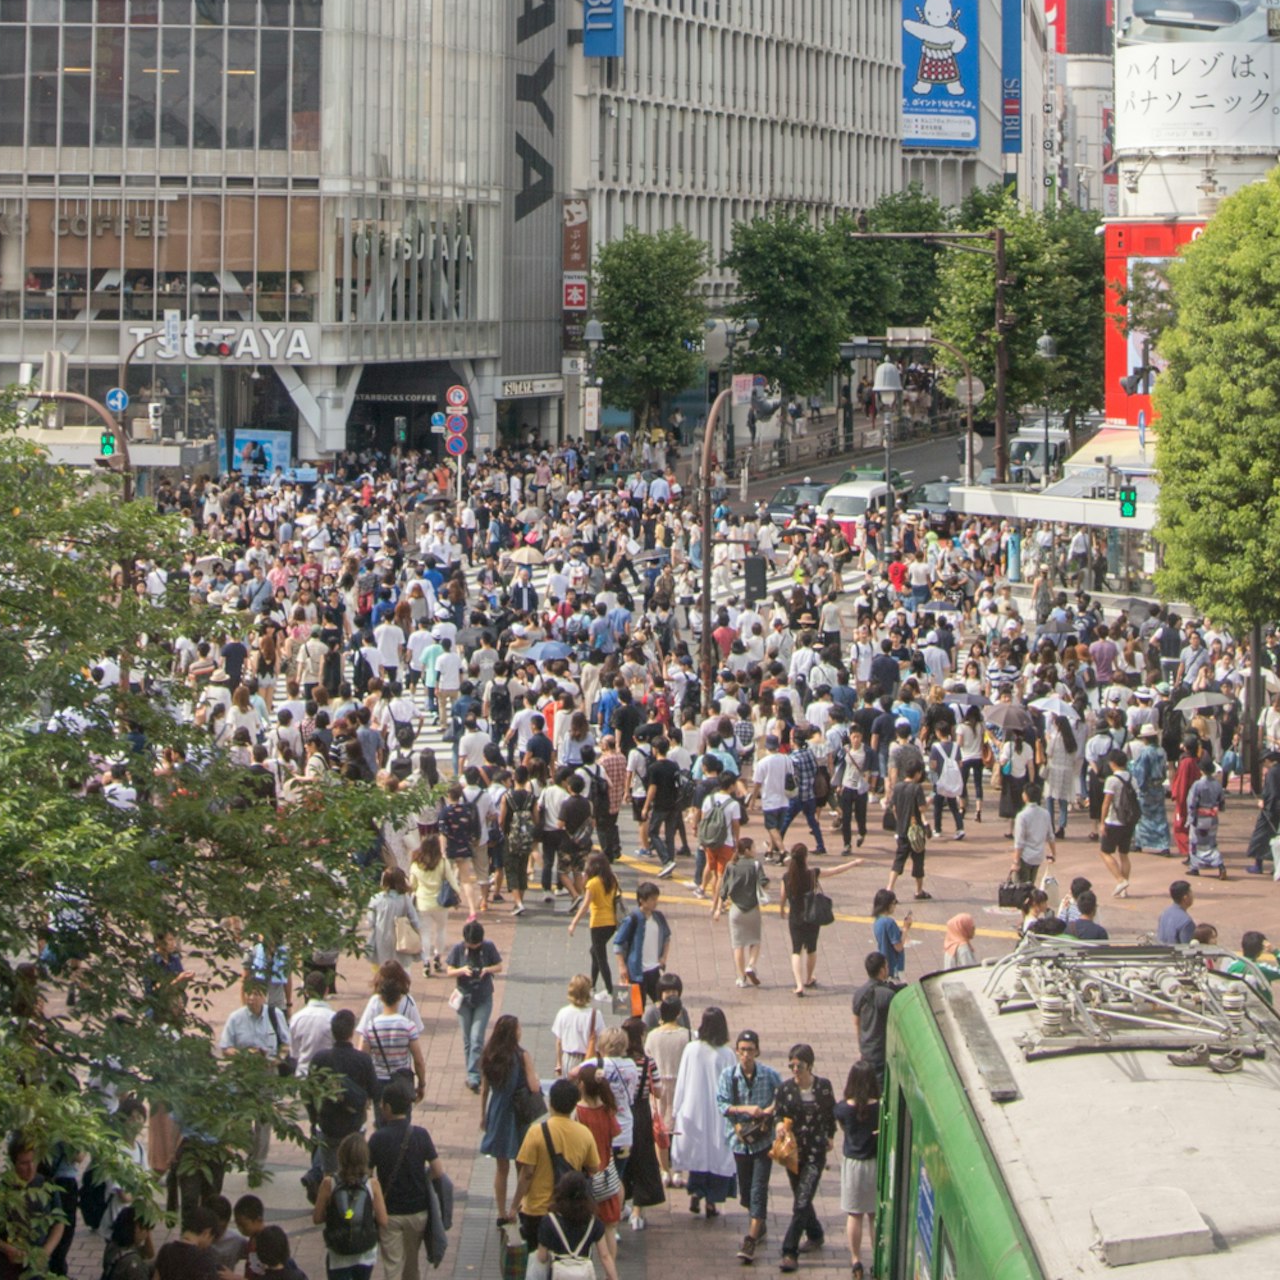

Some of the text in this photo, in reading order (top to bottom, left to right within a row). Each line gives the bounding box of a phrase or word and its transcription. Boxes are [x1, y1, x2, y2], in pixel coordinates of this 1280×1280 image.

[1126, 51, 1270, 81] ハイレゾは、
[1003, 77, 1020, 140] SEIBU
[1122, 89, 1280, 116] パナソニック。
[50, 215, 169, 238] COFFEE
[568, 285, 584, 304] 本
[405, 393, 438, 402] COFFEE
